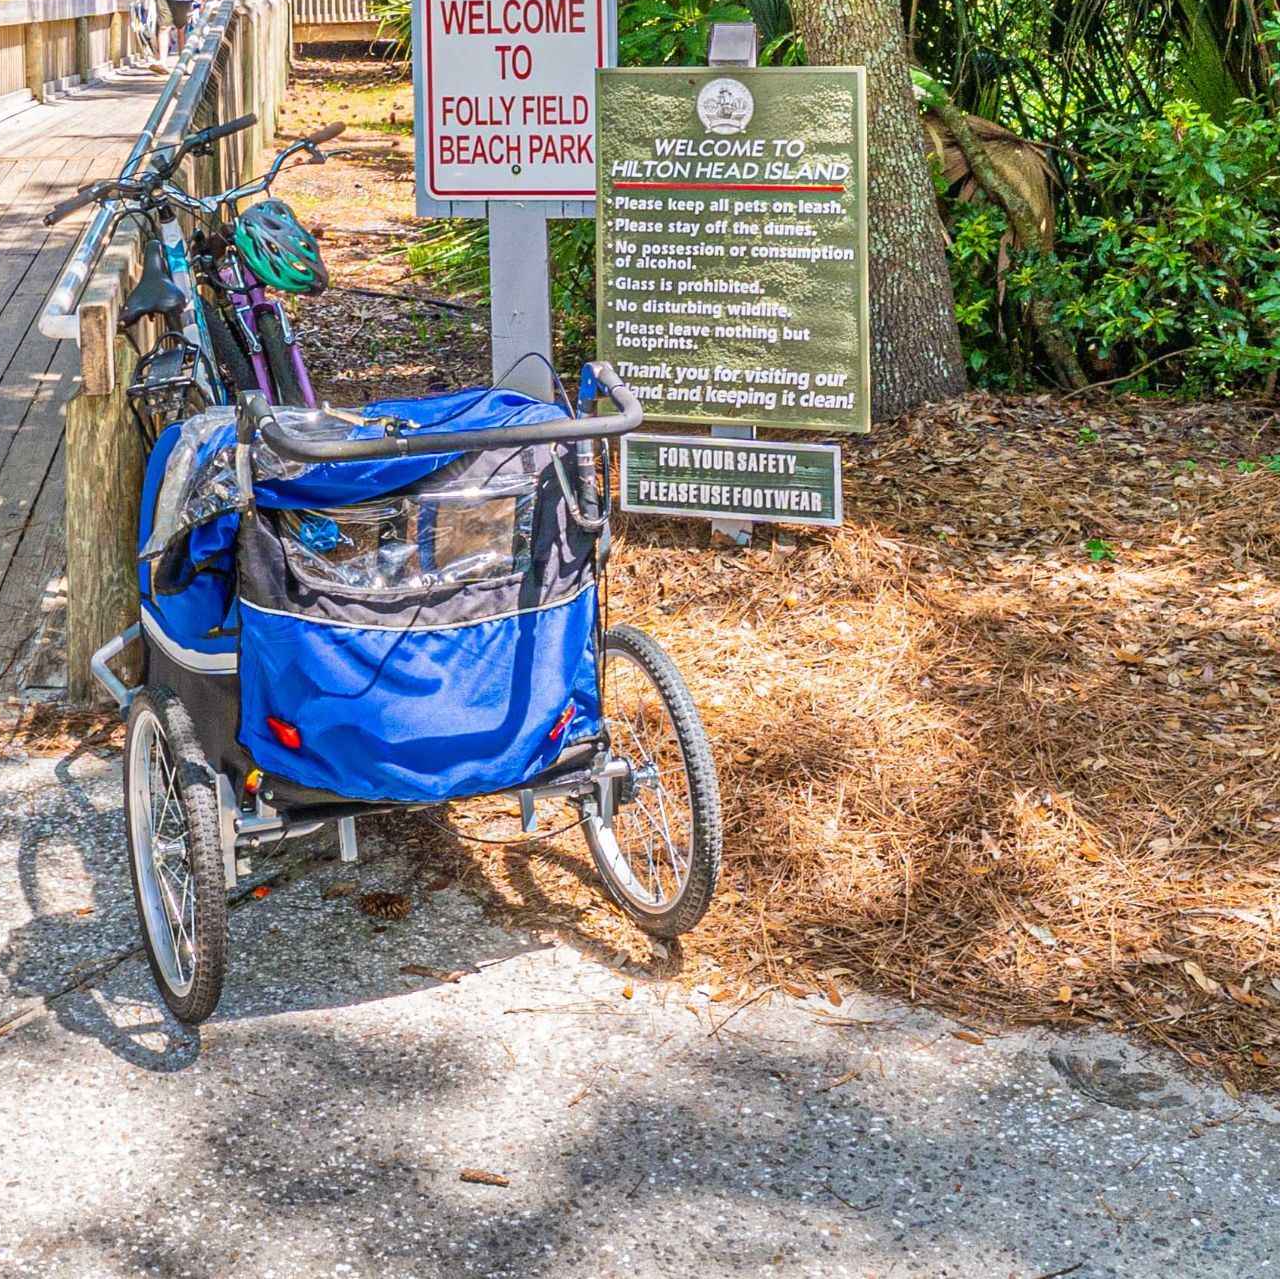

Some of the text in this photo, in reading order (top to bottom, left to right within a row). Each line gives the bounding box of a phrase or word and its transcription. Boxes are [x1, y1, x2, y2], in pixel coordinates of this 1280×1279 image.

[495, 44, 533, 80] TO
[442, 95, 589, 126] FOLLY FIELD
[439, 134, 594, 165] BEACH PARK
[654, 139, 805, 158] WELCOME TO
[611, 160, 850, 181] HILTON HEAD ISLAND
[615, 196, 846, 216] Please keep all pets on leash.
[615, 218, 818, 237] Please stay off the dunes.
[615, 240, 854, 263] No possession or consumption
[615, 256, 697, 271] of alcohol.
[616, 277, 765, 295] Glass is prohibited.
[616, 299, 792, 319] No disturbing wildlife.
[616, 321, 810, 344] Please leave nothing but
[616, 333, 699, 352] footprints.
[617, 361, 848, 388] Thank you for visiting our
[666, 385, 703, 402] and
[705, 385, 777, 410] keeping
[781, 390, 795, 407] it
[799, 391, 856, 410] clean!
[658, 446, 798, 475] FOR YOUR SAFETY
[639, 480, 822, 512] PLEASE USE FOOTWEAR
